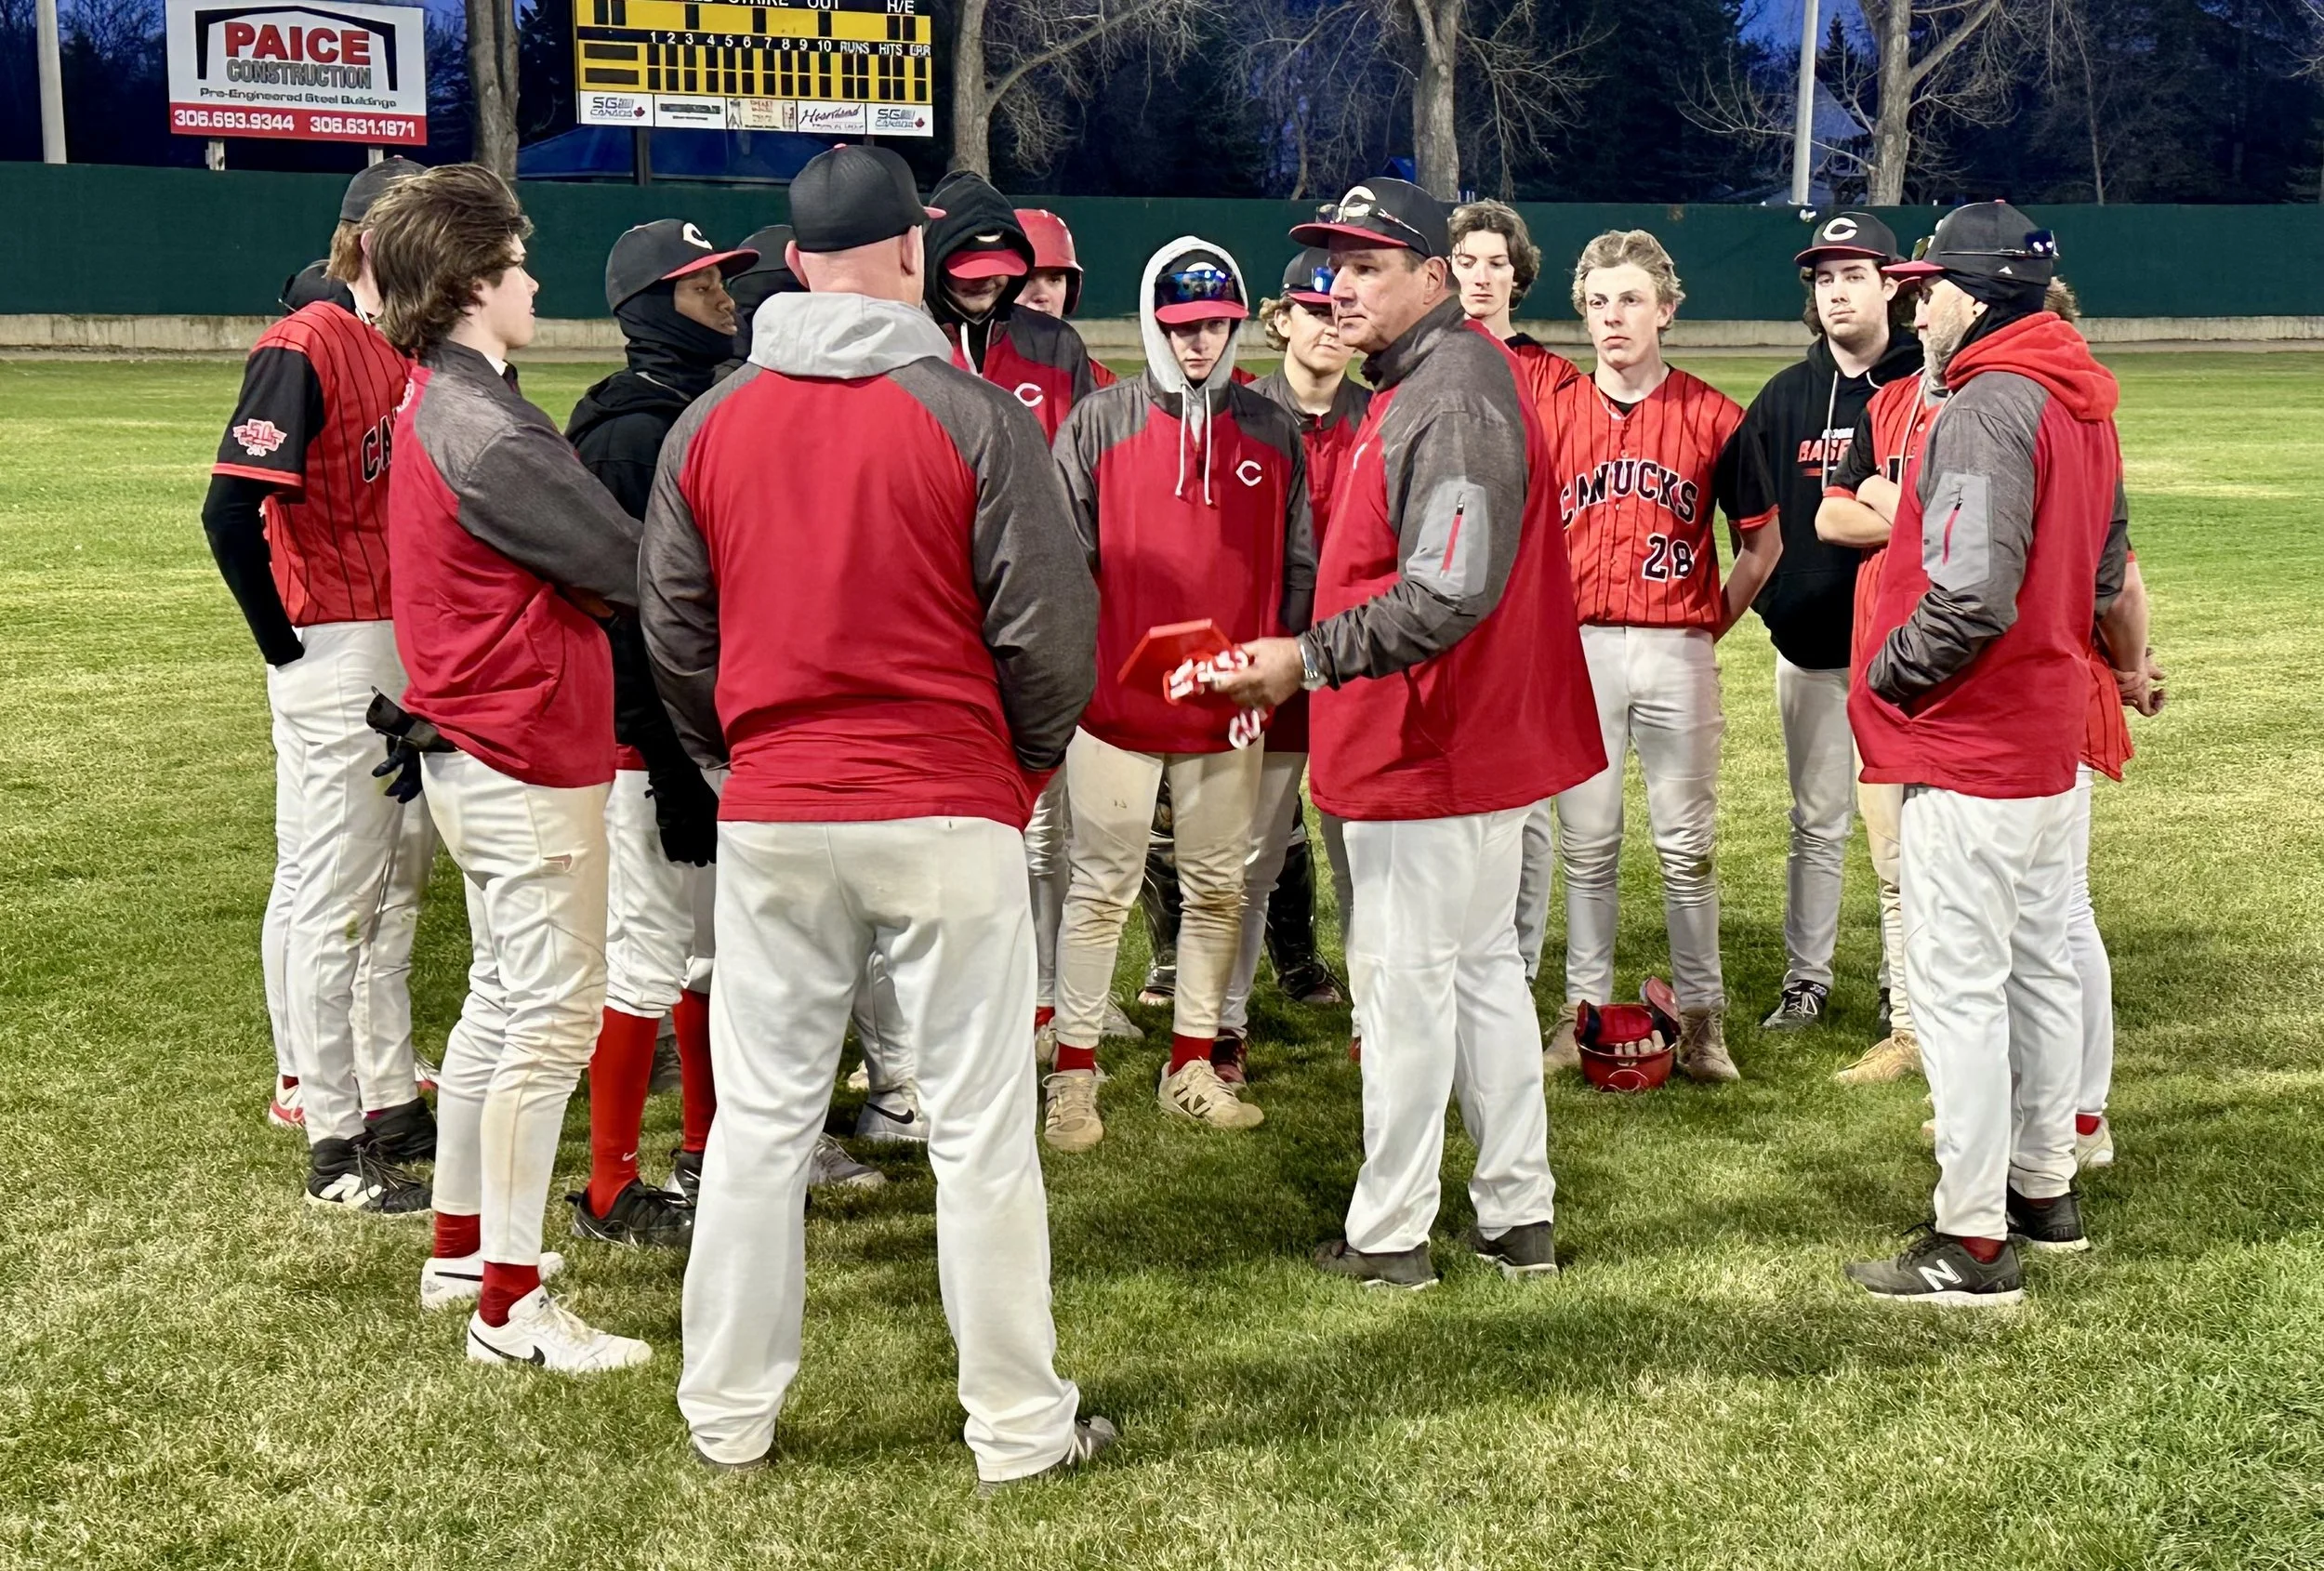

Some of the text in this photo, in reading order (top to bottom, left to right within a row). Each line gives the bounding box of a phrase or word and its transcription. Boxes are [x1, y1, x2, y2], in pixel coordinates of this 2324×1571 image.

[887, 0, 915, 14] H/E
[225, 22, 371, 65] PAICE
[651, 32, 657, 44] 1
[667, 33, 676, 45] 2
[685, 33, 693, 46] 3
[706, 34, 716, 46] 4
[725, 35, 733, 47] 5
[743, 36, 751, 48] 6
[764, 37, 772, 49] 7
[782, 38, 790, 50] 8
[799, 39, 808, 51] 9
[818, 40, 832, 52] 10
[840, 41, 869, 55] RUNS
[879, 44, 903, 56] HITS
[227, 59, 372, 89] CONSTRUCTION
[200, 87, 397, 109] Pre-Engineered Steel Buildings
[310, 115, 416, 138] 306.631.1871
[683, 222, 713, 250] C
[1822, 217, 1858, 242] C
[1013, 382, 1044, 407] C
[1235, 459, 1262, 487] C
[1560, 458, 1699, 530] CANUCKS
[1642, 533, 1695, 583] 28
